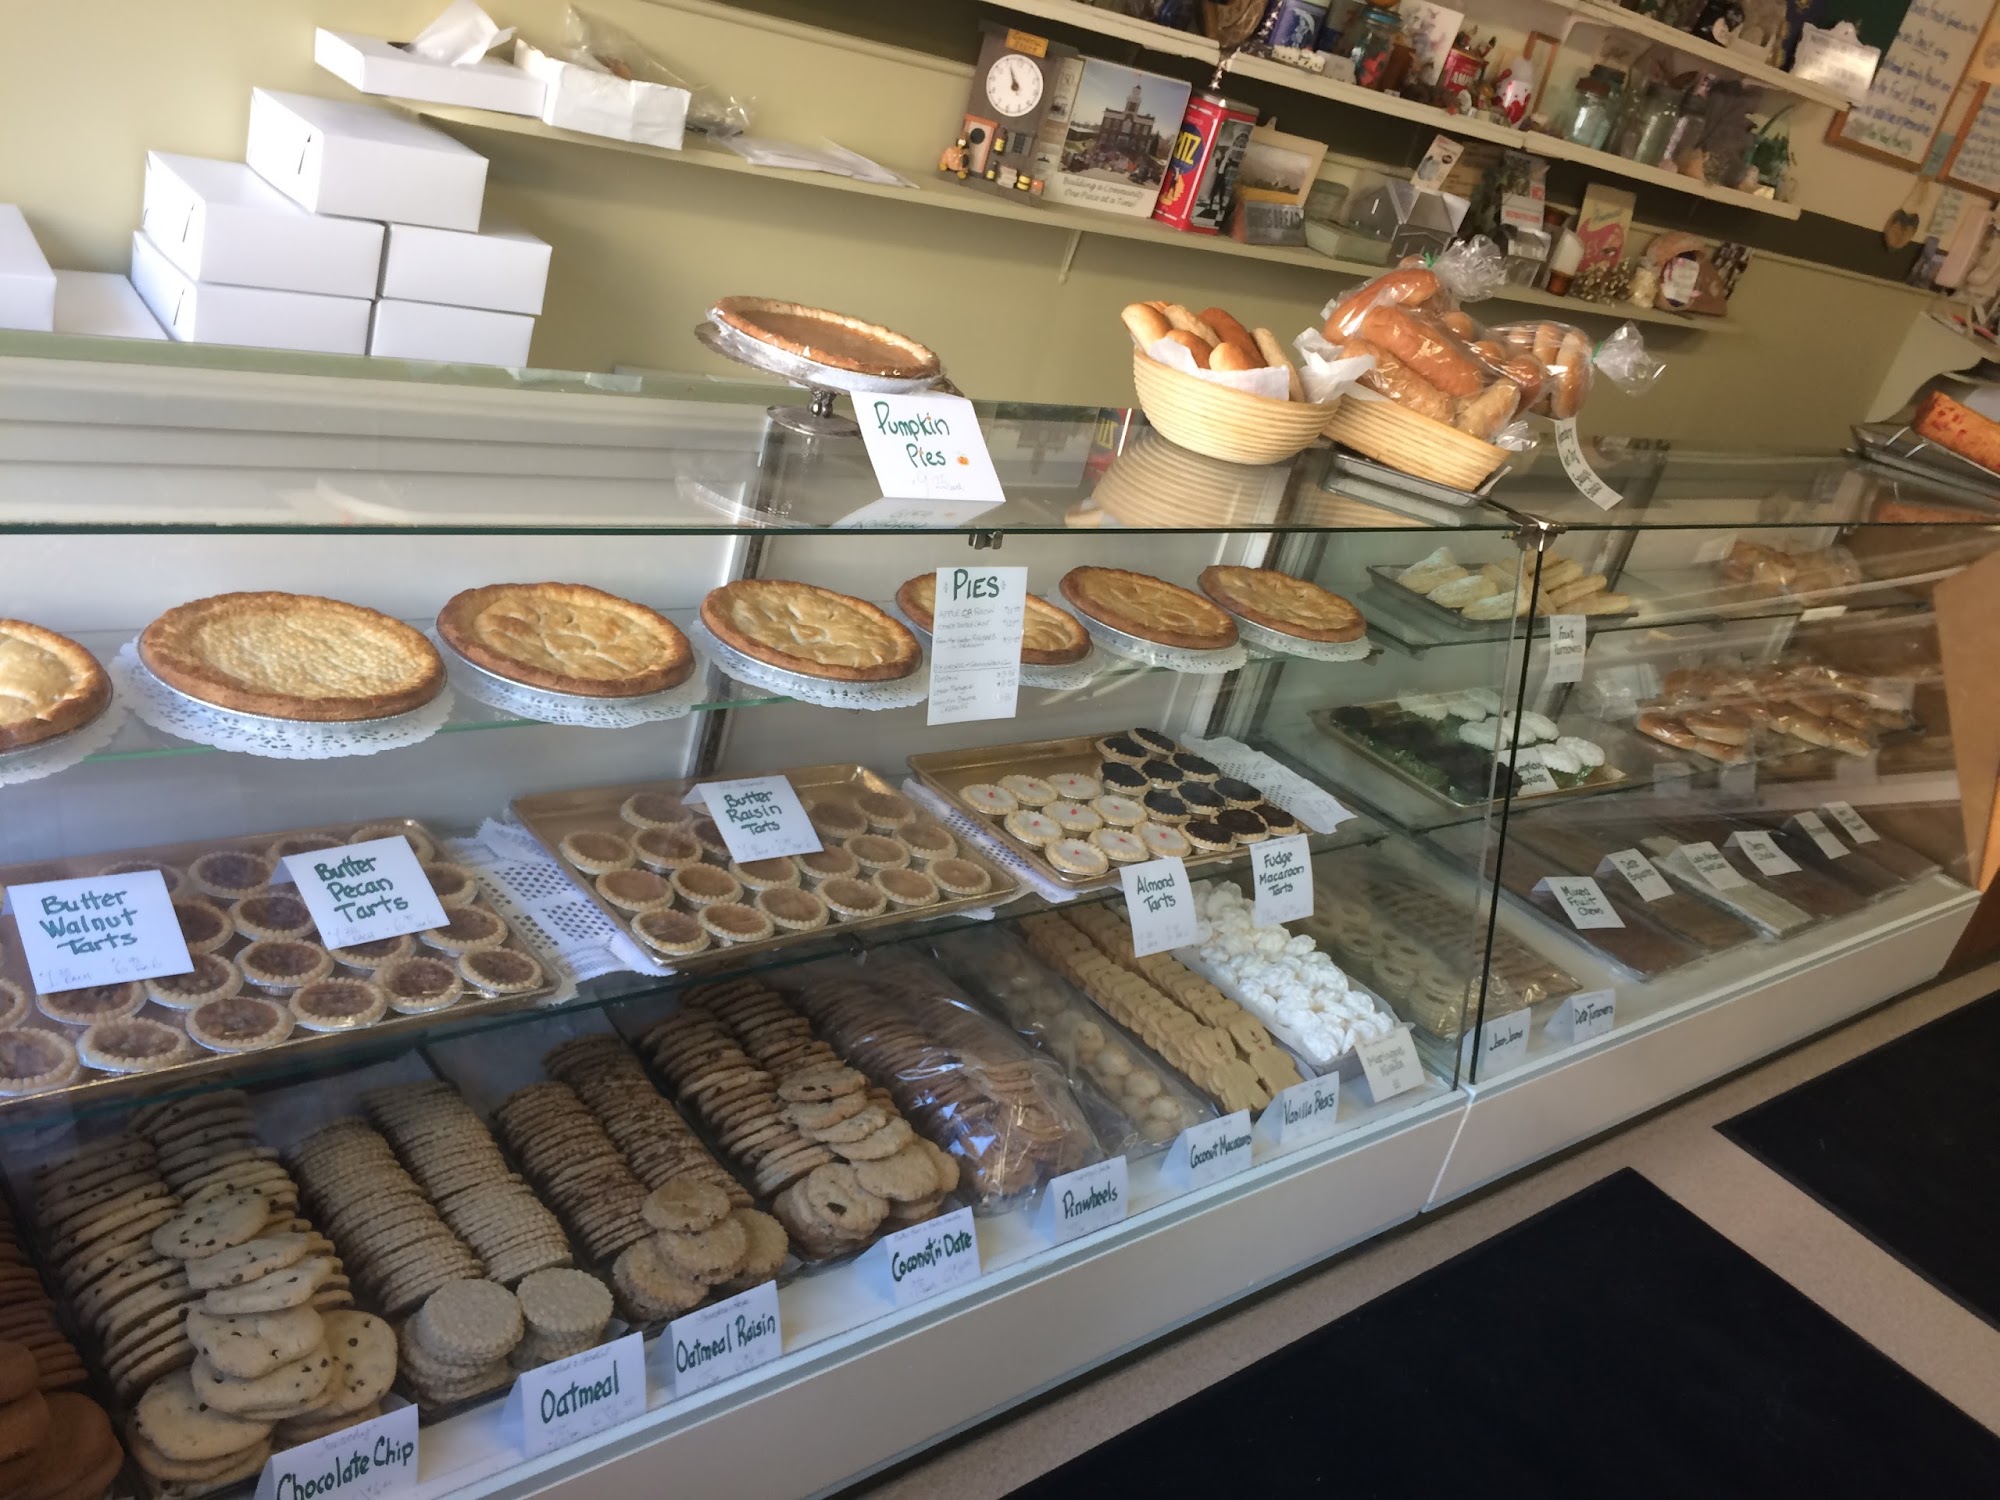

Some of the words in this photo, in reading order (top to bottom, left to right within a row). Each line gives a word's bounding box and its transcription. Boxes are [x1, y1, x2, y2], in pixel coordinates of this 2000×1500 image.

[874, 401, 950, 441] Pumpkin
[906, 443, 946, 468] Pies
[953, 568, 1000, 601] PIES
[724, 791, 773, 808] Butter
[725, 804, 782, 823] Raisin
[741, 820, 780, 835] Tarts
[314, 855, 377, 882] Butter
[1263, 851, 1293, 868] Fudge
[1137, 872, 1175, 895] Almond
[1259, 865, 1305, 886] Macaroon
[326, 877, 394, 903] Pecan
[1268, 882, 1294, 896] Tarts
[40, 890, 128, 916] Butter
[334, 895, 409, 923] Tarts
[1143, 893, 1176, 912] Tarts
[38, 908, 138, 939] Walnut
[56, 932, 138, 956] Tarts
[1284, 1099, 1313, 1125] Vanilla
[1190, 1141, 1218, 1169] Coconut
[1062, 1181, 1119, 1220] Pinwheels
[892, 1237, 936, 1282] Coconut
[943, 1229, 973, 1257] Date
[676, 1323, 732, 1373] Oatmeal
[735, 1313, 776, 1348] Raisin
[540, 1360, 620, 1425] Oatmeal
[276, 1450, 370, 1500] Chocolate
[373, 1434, 414, 1467] Chip
